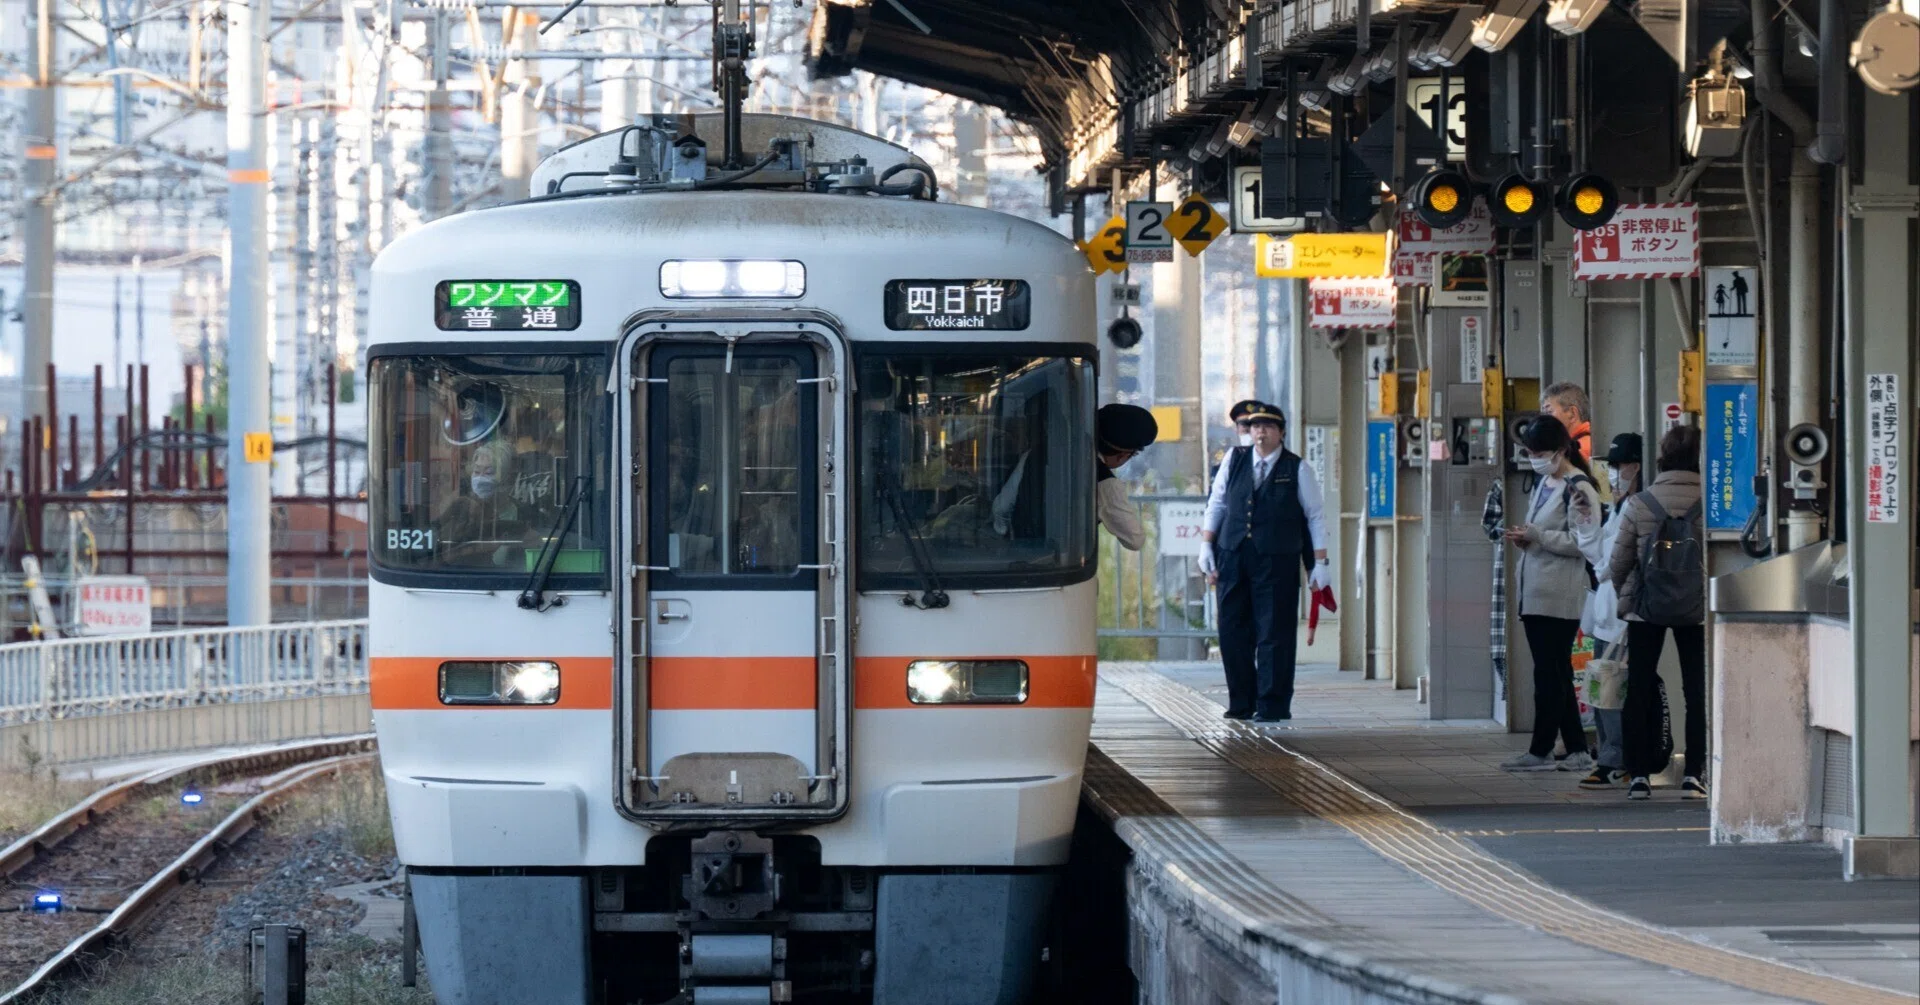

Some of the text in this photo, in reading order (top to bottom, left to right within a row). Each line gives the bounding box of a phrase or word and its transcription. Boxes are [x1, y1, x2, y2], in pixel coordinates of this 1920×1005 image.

[1137, 207, 1162, 240] 2
[1180, 201, 1212, 241] 2
[1622, 217, 1687, 234] 非常停止
[1585, 225, 1616, 238] SOS
[1103, 226, 1126, 262] 3
[1299, 245, 1376, 259] エレベーター
[1631, 237, 1679, 253] ボタン
[452, 283, 568, 306] ワンマン
[908, 285, 1004, 315] 四日市
[1349, 300, 1382, 310] ボタン
[461, 307, 557, 328] 普通
[925, 315, 984, 327] Yokkaichi
[250, 441, 265, 460] 14
[387, 529, 433, 550] B521
